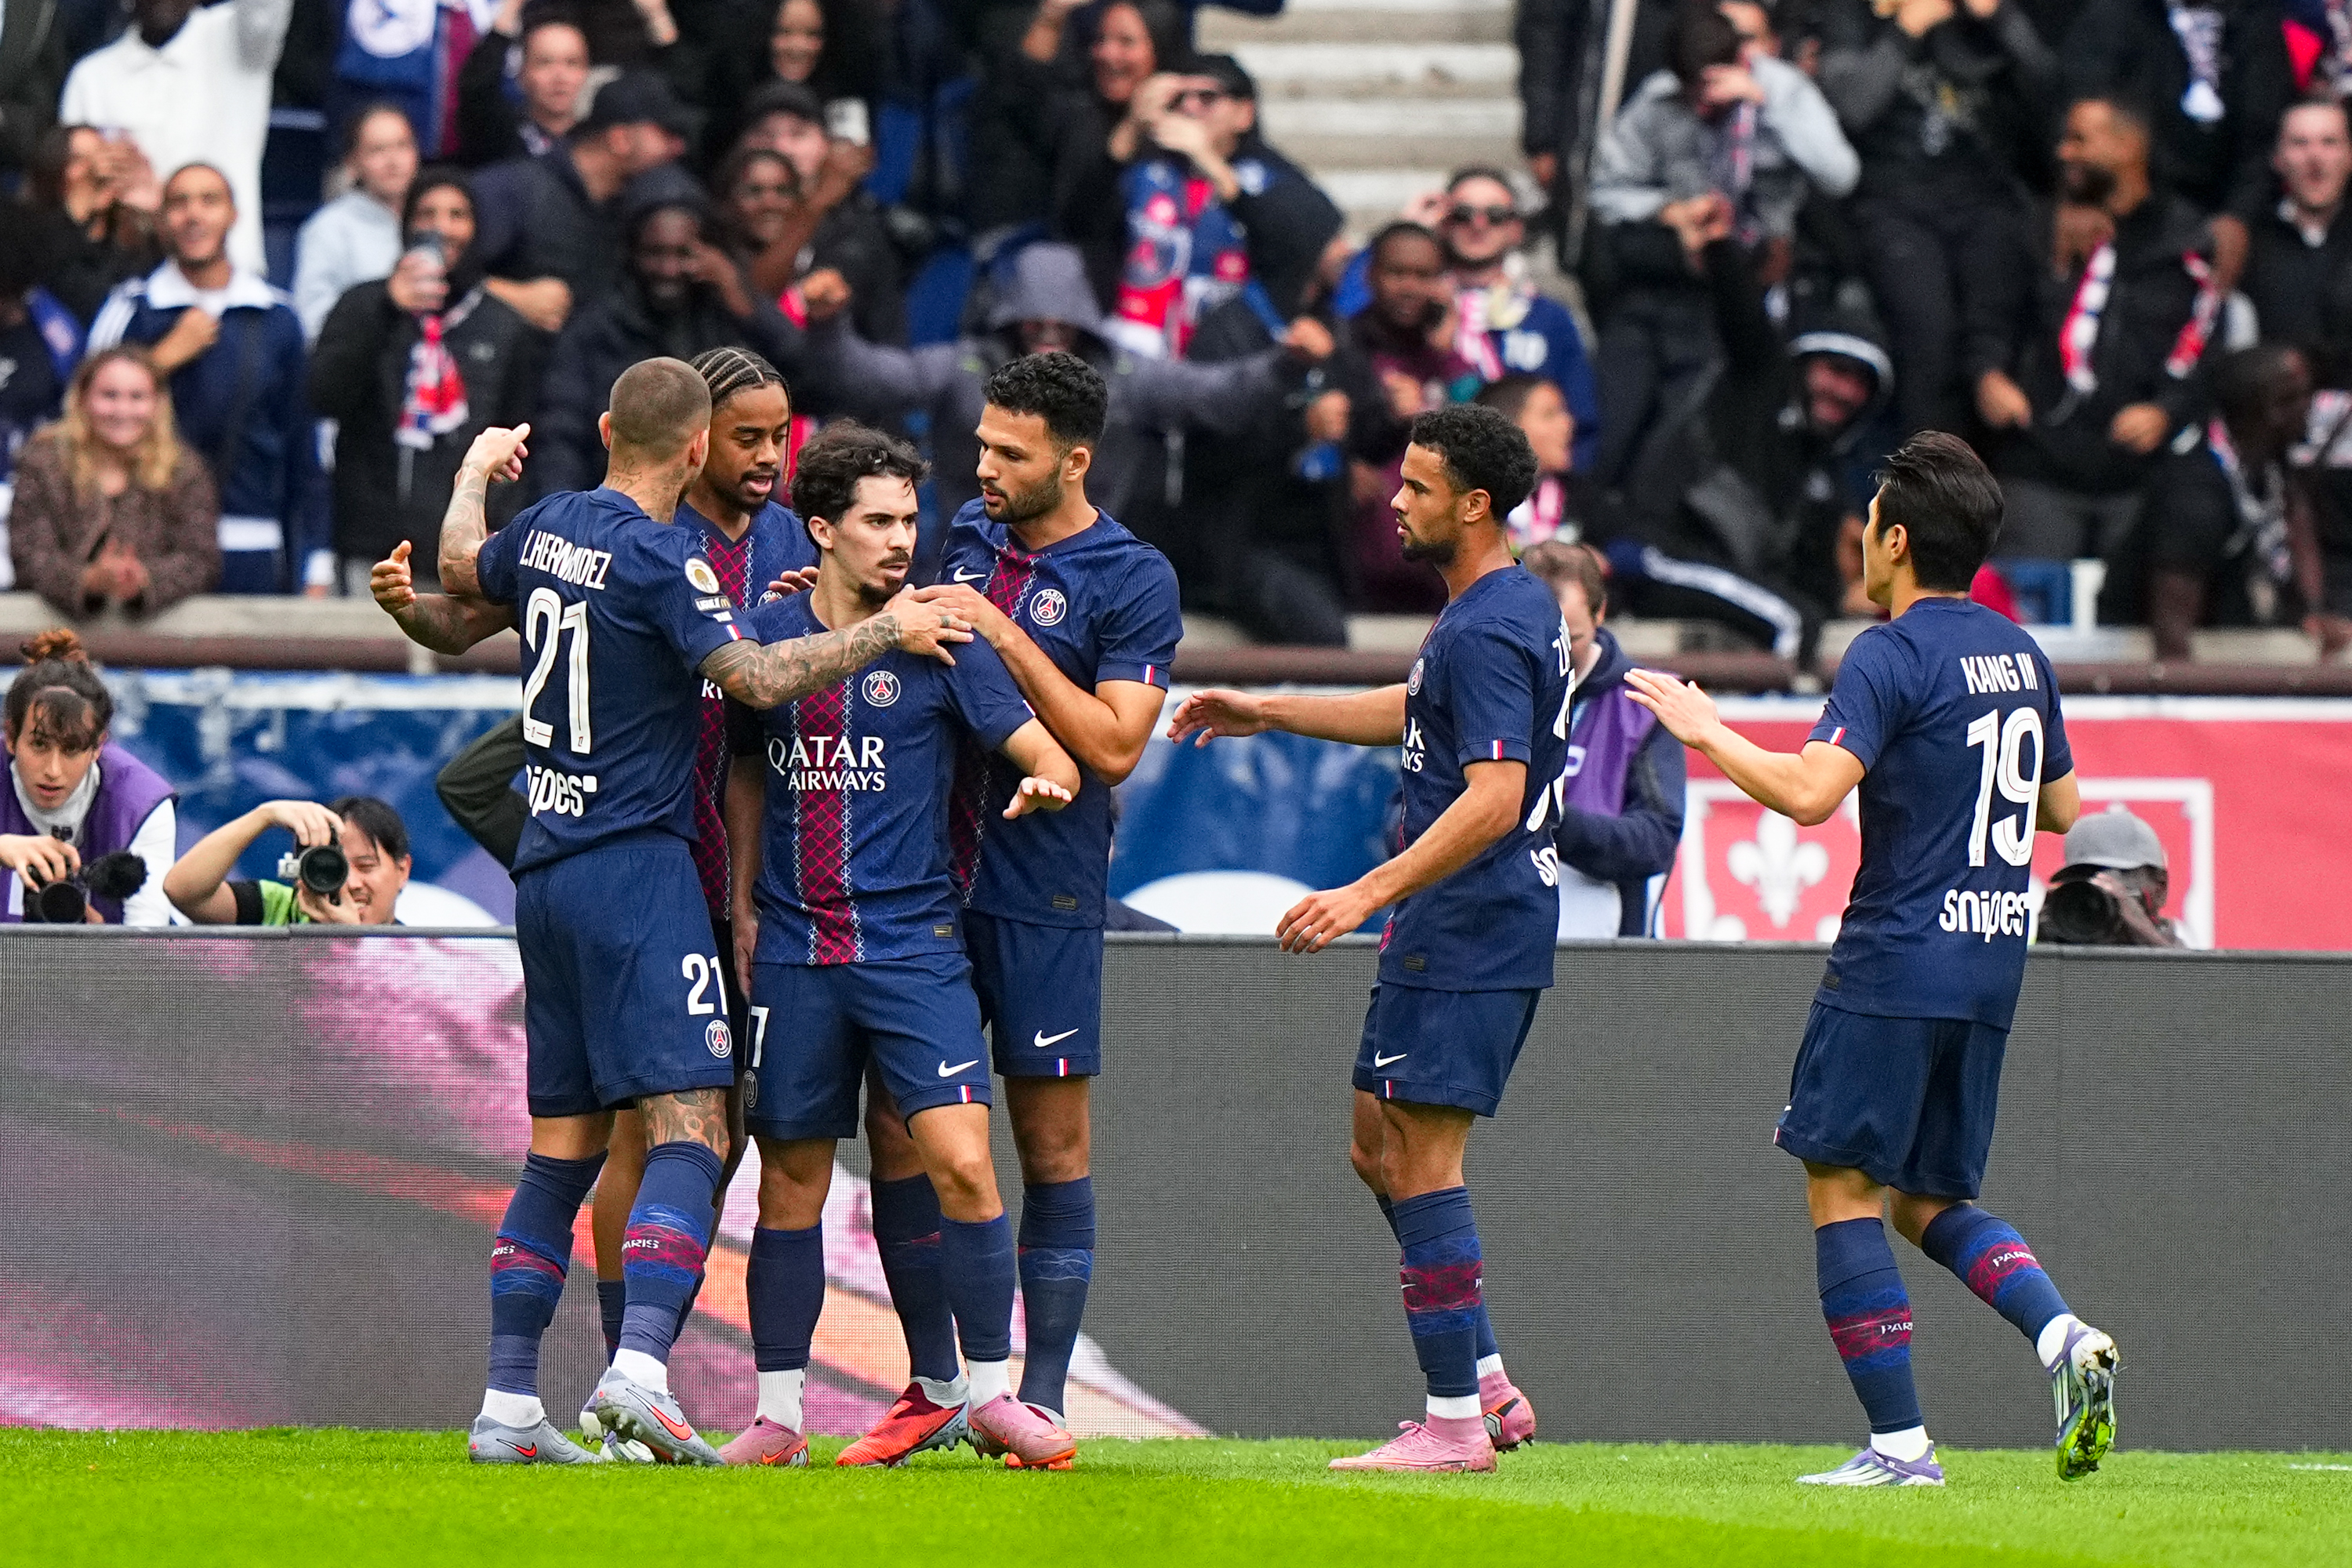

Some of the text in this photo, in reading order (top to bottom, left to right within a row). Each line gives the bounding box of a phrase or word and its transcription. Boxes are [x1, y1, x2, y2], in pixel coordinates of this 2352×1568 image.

[1041, 592, 1064, 604] PARIS
[524, 587, 590, 754] 21
[869, 673, 893, 682] PARIS
[1960, 653, 2038, 695] KANG IN
[768, 735, 886, 776] QATAR
[788, 771, 886, 792] AIRWAYS
[1966, 706, 2043, 866] 19
[1939, 889, 2030, 943] snipes
[682, 953, 728, 1014] 21
